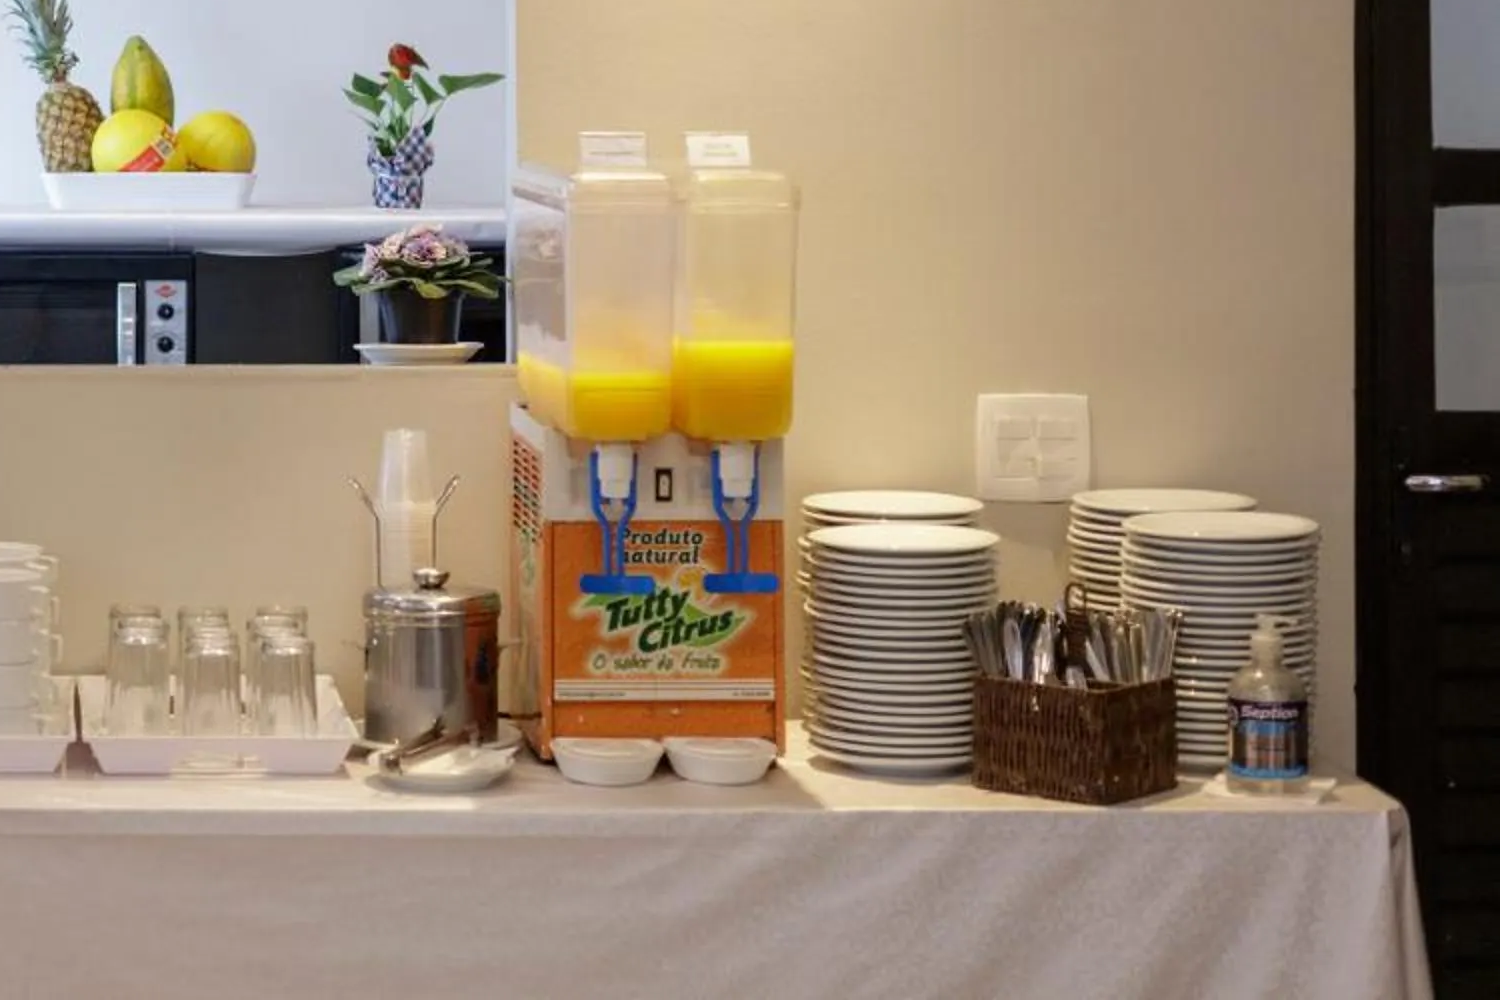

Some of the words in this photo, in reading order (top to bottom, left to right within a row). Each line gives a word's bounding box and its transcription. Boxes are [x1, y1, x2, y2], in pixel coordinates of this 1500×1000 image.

[606, 587, 690, 632] Tutty
[639, 610, 734, 653] Citrus
[593, 653, 607, 670] O
